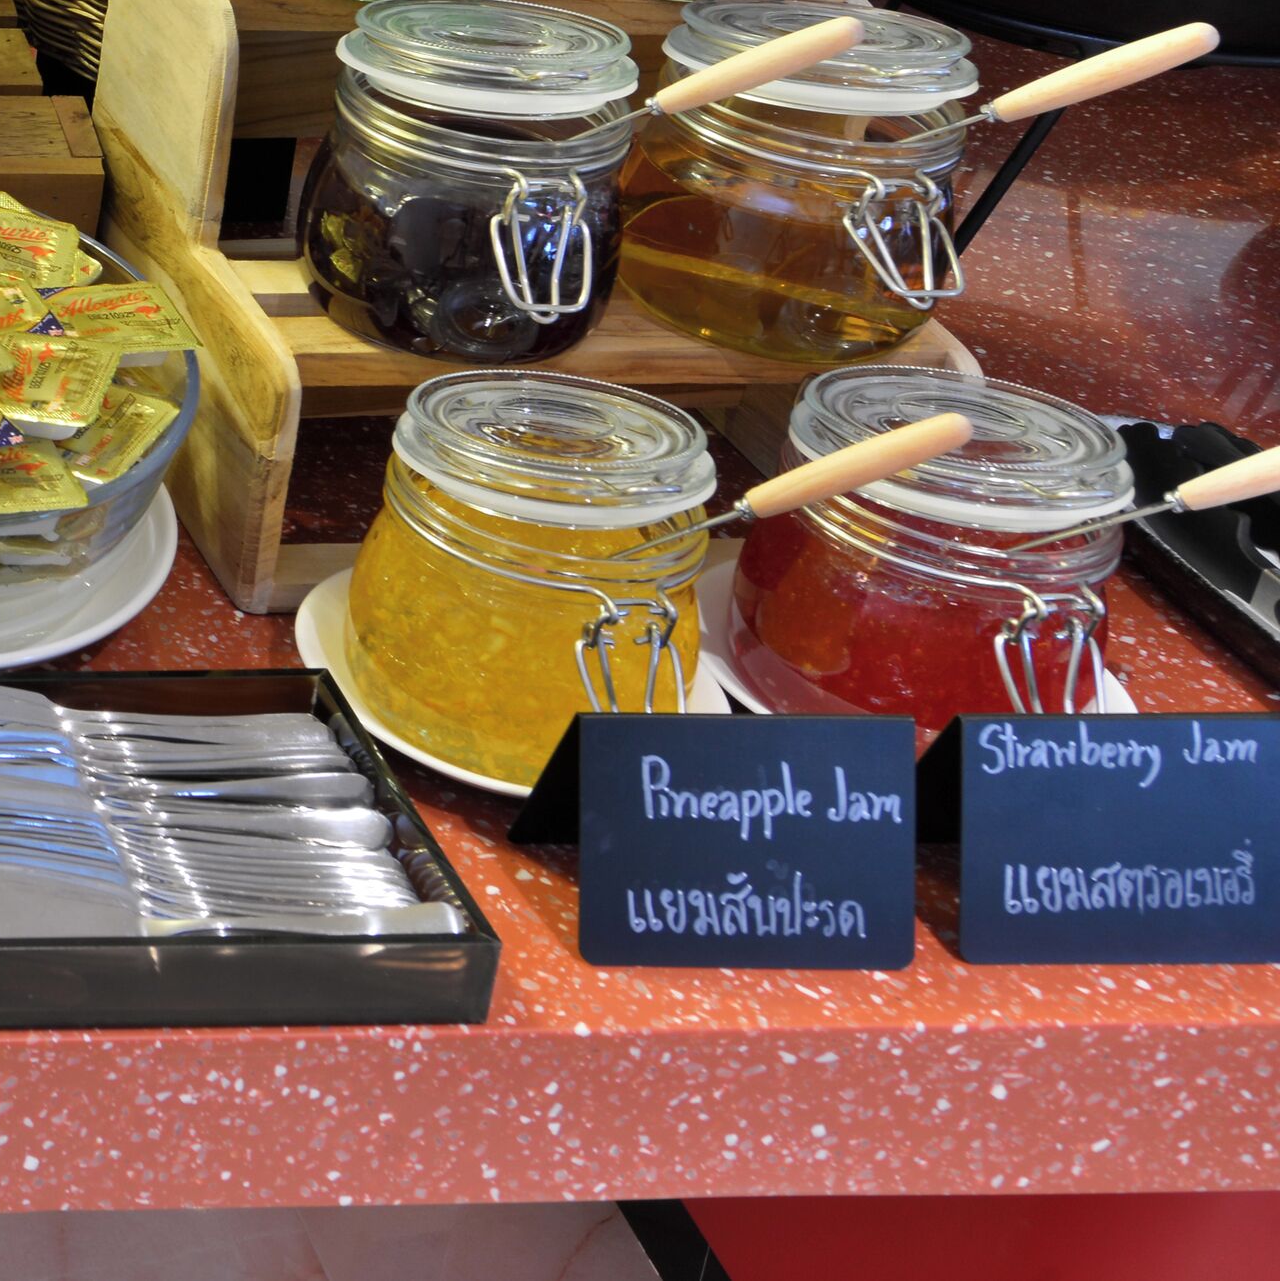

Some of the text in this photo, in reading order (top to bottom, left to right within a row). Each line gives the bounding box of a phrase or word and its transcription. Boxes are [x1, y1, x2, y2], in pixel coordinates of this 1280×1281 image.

[979, 720, 1258, 787] Strawberry Jam
[642, 754, 903, 840] Pineapple Jam
